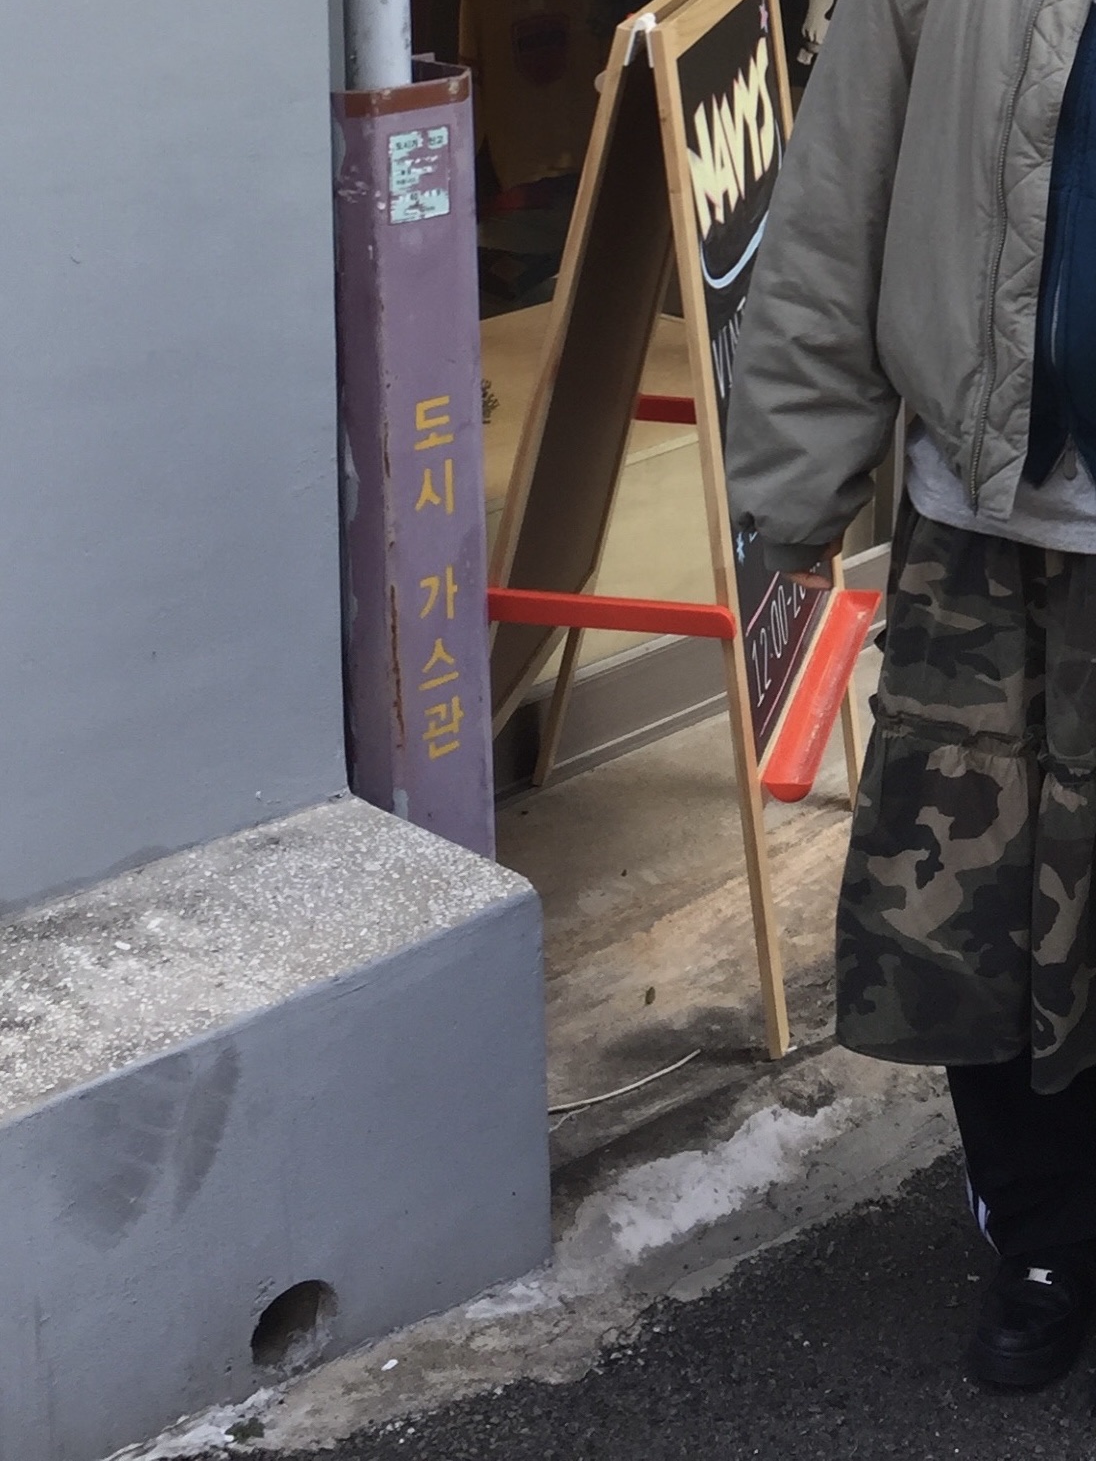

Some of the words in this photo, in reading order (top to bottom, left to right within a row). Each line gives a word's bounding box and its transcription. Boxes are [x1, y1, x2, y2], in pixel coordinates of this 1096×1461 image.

[688, 36, 774, 241] NAVYS
[414, 396, 454, 517] 도시
[418, 565, 465, 760] 가스관
